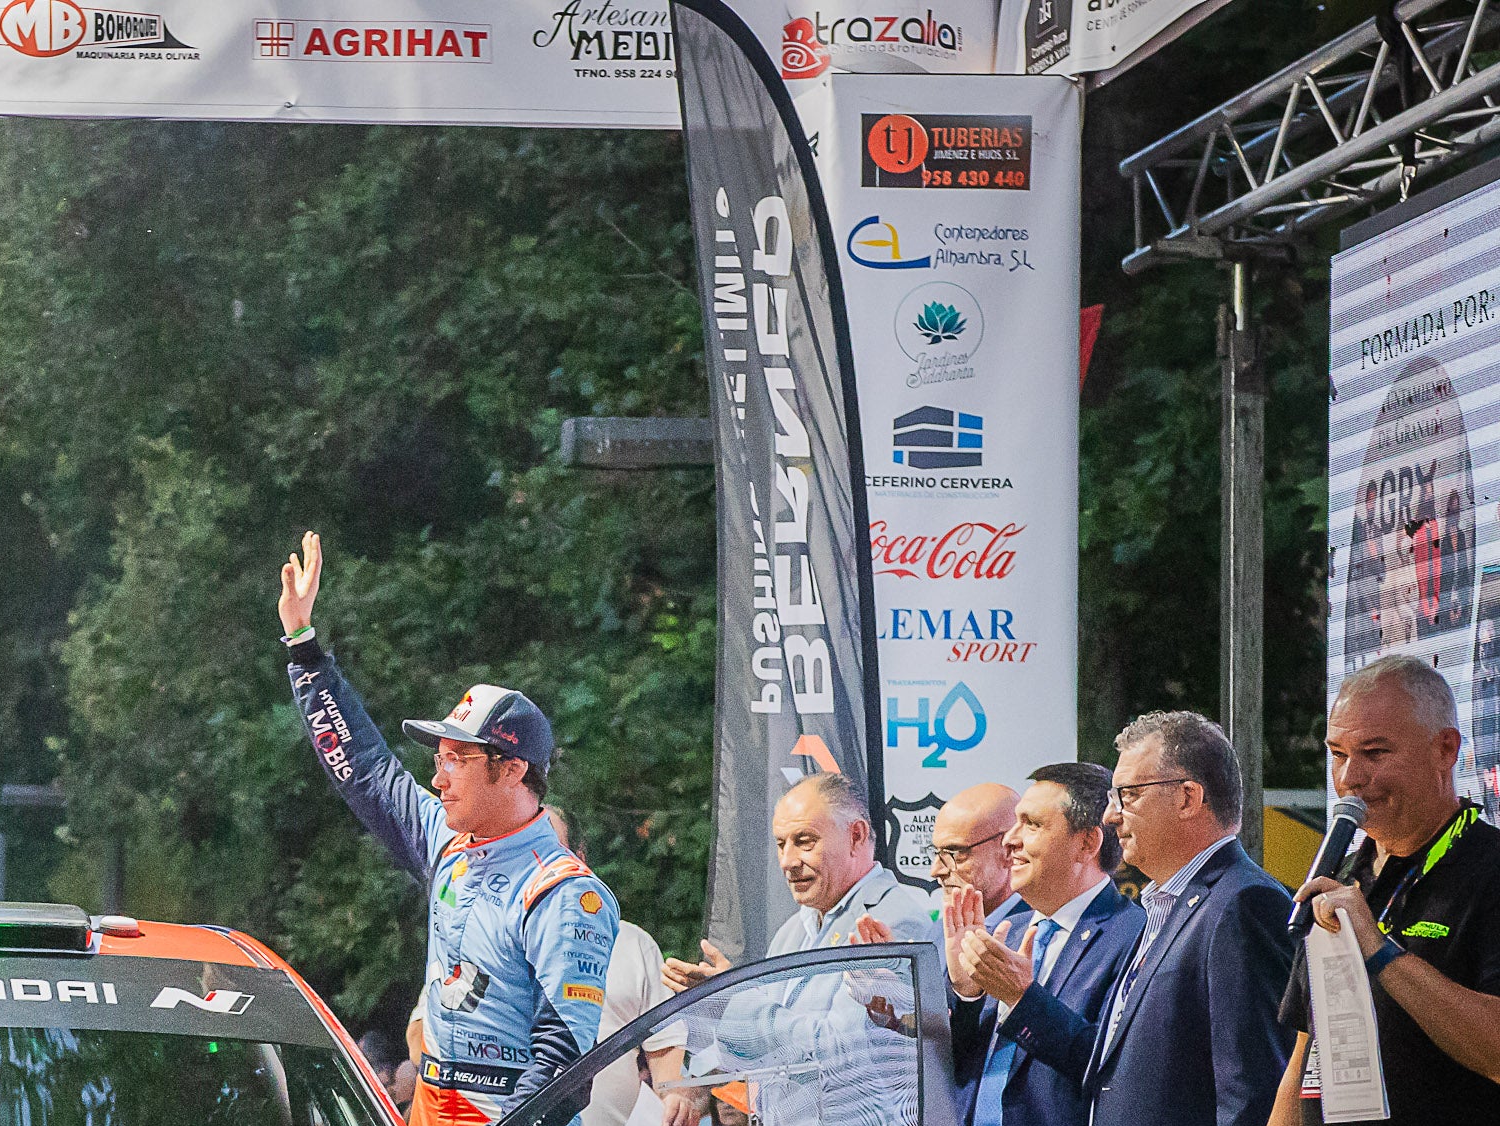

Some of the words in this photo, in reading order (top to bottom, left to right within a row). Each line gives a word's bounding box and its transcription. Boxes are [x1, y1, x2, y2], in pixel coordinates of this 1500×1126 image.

[533, 0, 671, 48] Artesan
[815, 9, 957, 50] trazalia
[303, 28, 488, 58] AGRIHAT
[76, 51, 136, 60] MAQUINARIA
[139, 52, 163, 60] PARA
[574, 68, 611, 79] TFNO.
[615, 69, 637, 79] 958
[640, 69, 663, 79] 224
[931, 128, 1023, 148] TUBERIAS
[921, 170, 952, 186] 958
[957, 171, 990, 186] 430
[994, 171, 1025, 187] 440
[934, 223, 1030, 245] Contenedores
[1361, 307, 1446, 369] FORMADA
[1453, 289, 1496, 334] POR:
[916, 351, 970, 370] Jardines
[940, 477, 1013, 489] CERVERA
[878, 608, 1017, 641] EMAR
[947, 642, 1038, 663] SPORT
[319, 689, 352, 744] HYUNDAI
[306, 709, 355, 782] MOBIS
[912, 815, 936, 823] ALAR
[903, 825, 934, 833] CONEC
[899, 855, 932, 866] aca
[574, 929, 608, 948] MOBIS
[456, 1029, 498, 1043] HYUNDAI
[468, 1042, 531, 1064] MOBIS
[442, 1070, 452, 1081] T.
[454, 1071, 509, 1087] NEUVILLE
